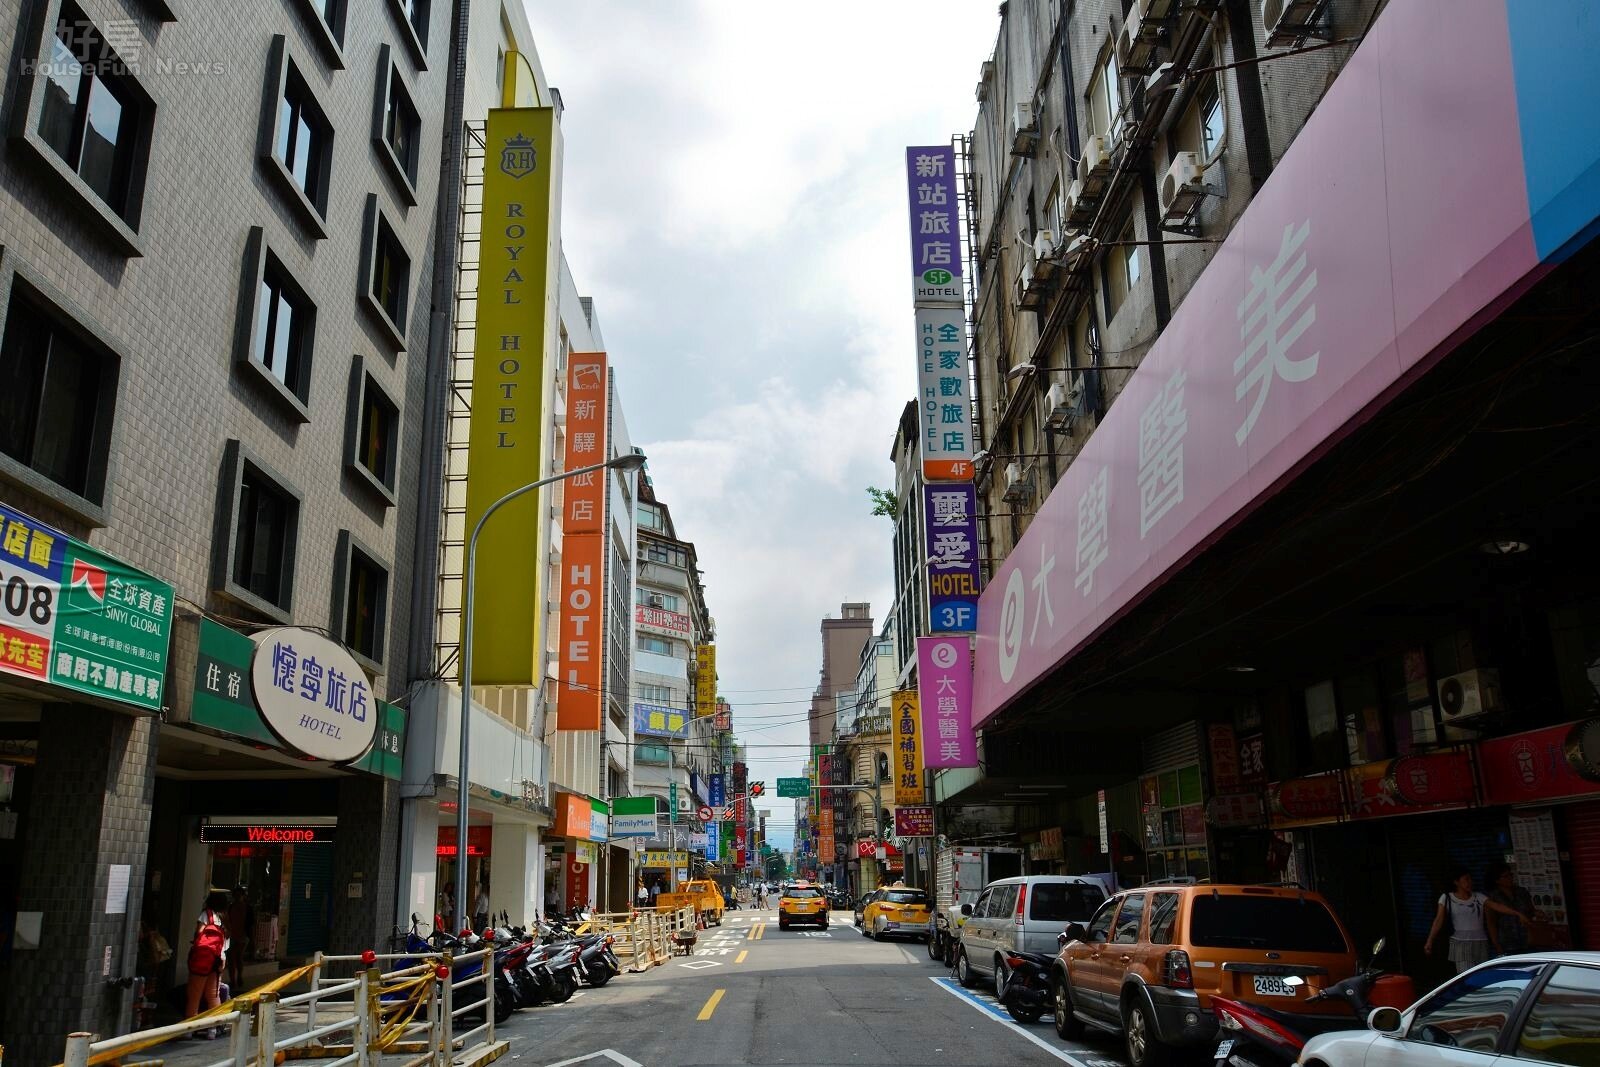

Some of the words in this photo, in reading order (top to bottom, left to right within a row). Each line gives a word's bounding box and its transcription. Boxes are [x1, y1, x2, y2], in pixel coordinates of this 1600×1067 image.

[506, 152, 532, 170] RH
[915, 154, 951, 265] 新站旅店
[503, 203, 526, 305] ROYAL
[918, 288, 960, 296] HOTEL
[923, 323, 934, 373] HOPE
[497, 335, 521, 448] HOTEL
[937, 323, 965, 452] 全家歡旅店
[925, 387, 937, 452] HOTEL
[1030, 218, 1321, 647] 大學醫美
[571, 399, 597, 521] 新驛旅店
[950, 462, 967, 476] 4F
[0, 514, 55, 570] 店面
[107, 578, 166, 618] 全球資產
[931, 573, 979, 595] HOTEL
[105, 605, 128, 625] SINYI
[130, 614, 162, 636] GLOBAL
[568, 564, 592, 691] HOTEL
[941, 607, 971, 627] 3F
[56, 652, 161, 702] 商用不動產專家
[206, 662, 242, 700] 住宿
[272, 640, 367, 723] 懷寧旅店
[300, 713, 342, 740] HOTEL
[936, 675, 961, 762] 大學醫美
[898, 701, 919, 790] 全國補習班
[247, 827, 315, 841] Welcome
[614, 819, 654, 828] FamilyMart
